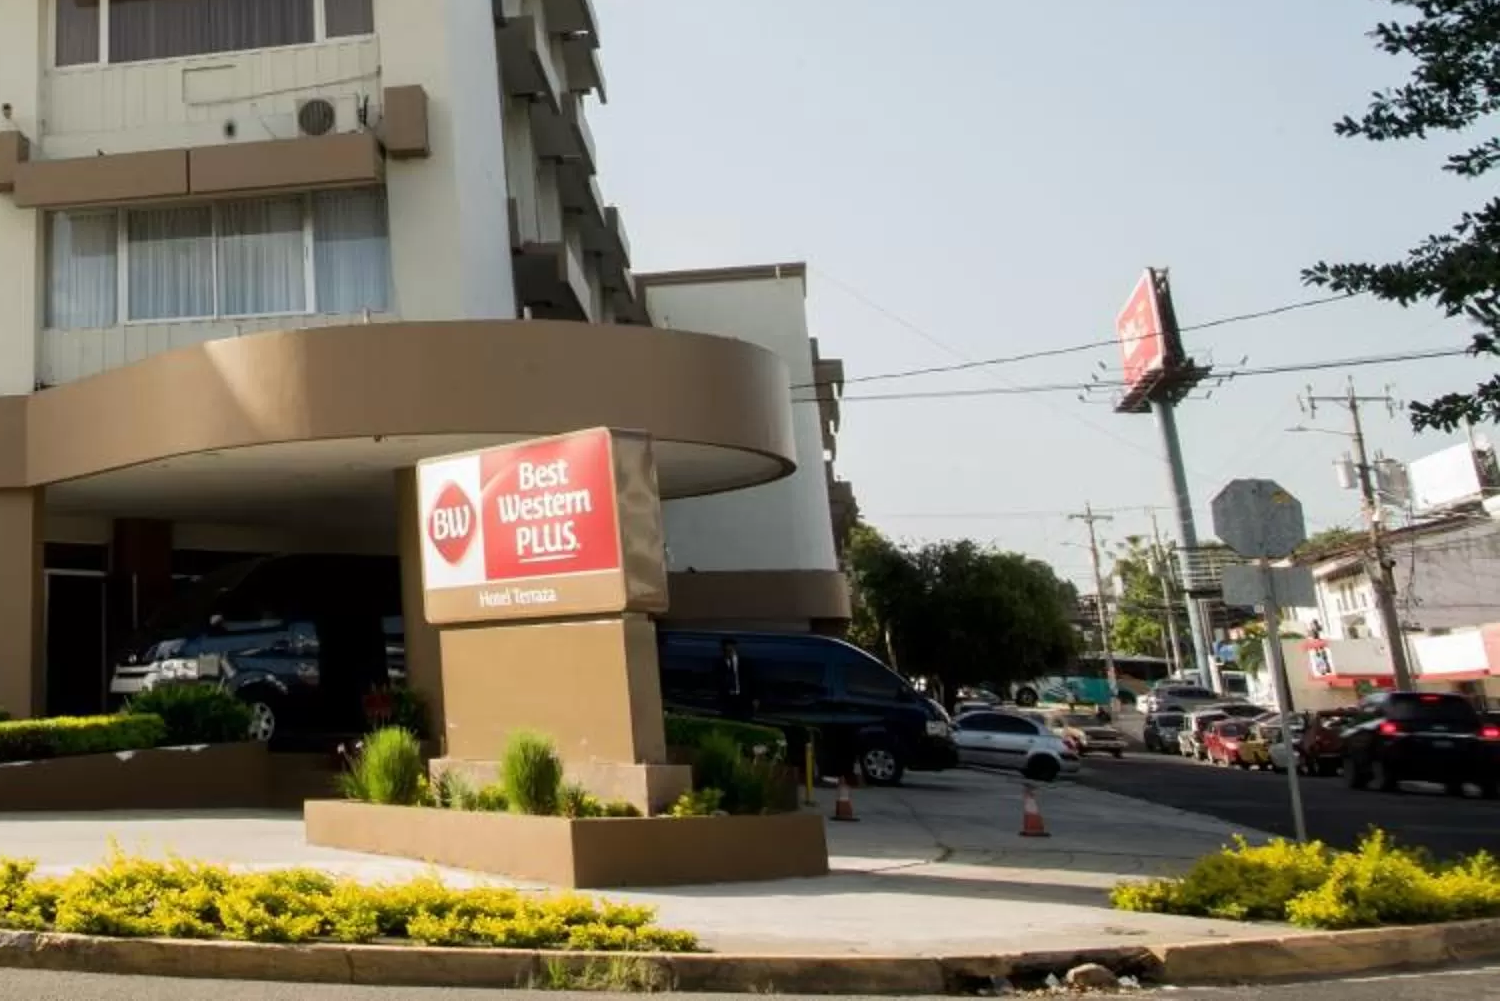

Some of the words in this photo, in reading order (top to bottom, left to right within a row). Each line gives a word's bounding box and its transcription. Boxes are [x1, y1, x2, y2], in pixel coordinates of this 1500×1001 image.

[519, 459, 569, 490] Best
[432, 504, 471, 540] BW
[496, 488, 592, 524] Western
[515, 520, 577, 555] PLUS
[479, 587, 512, 608] Hotel
[512, 586, 558, 605] Terraza
